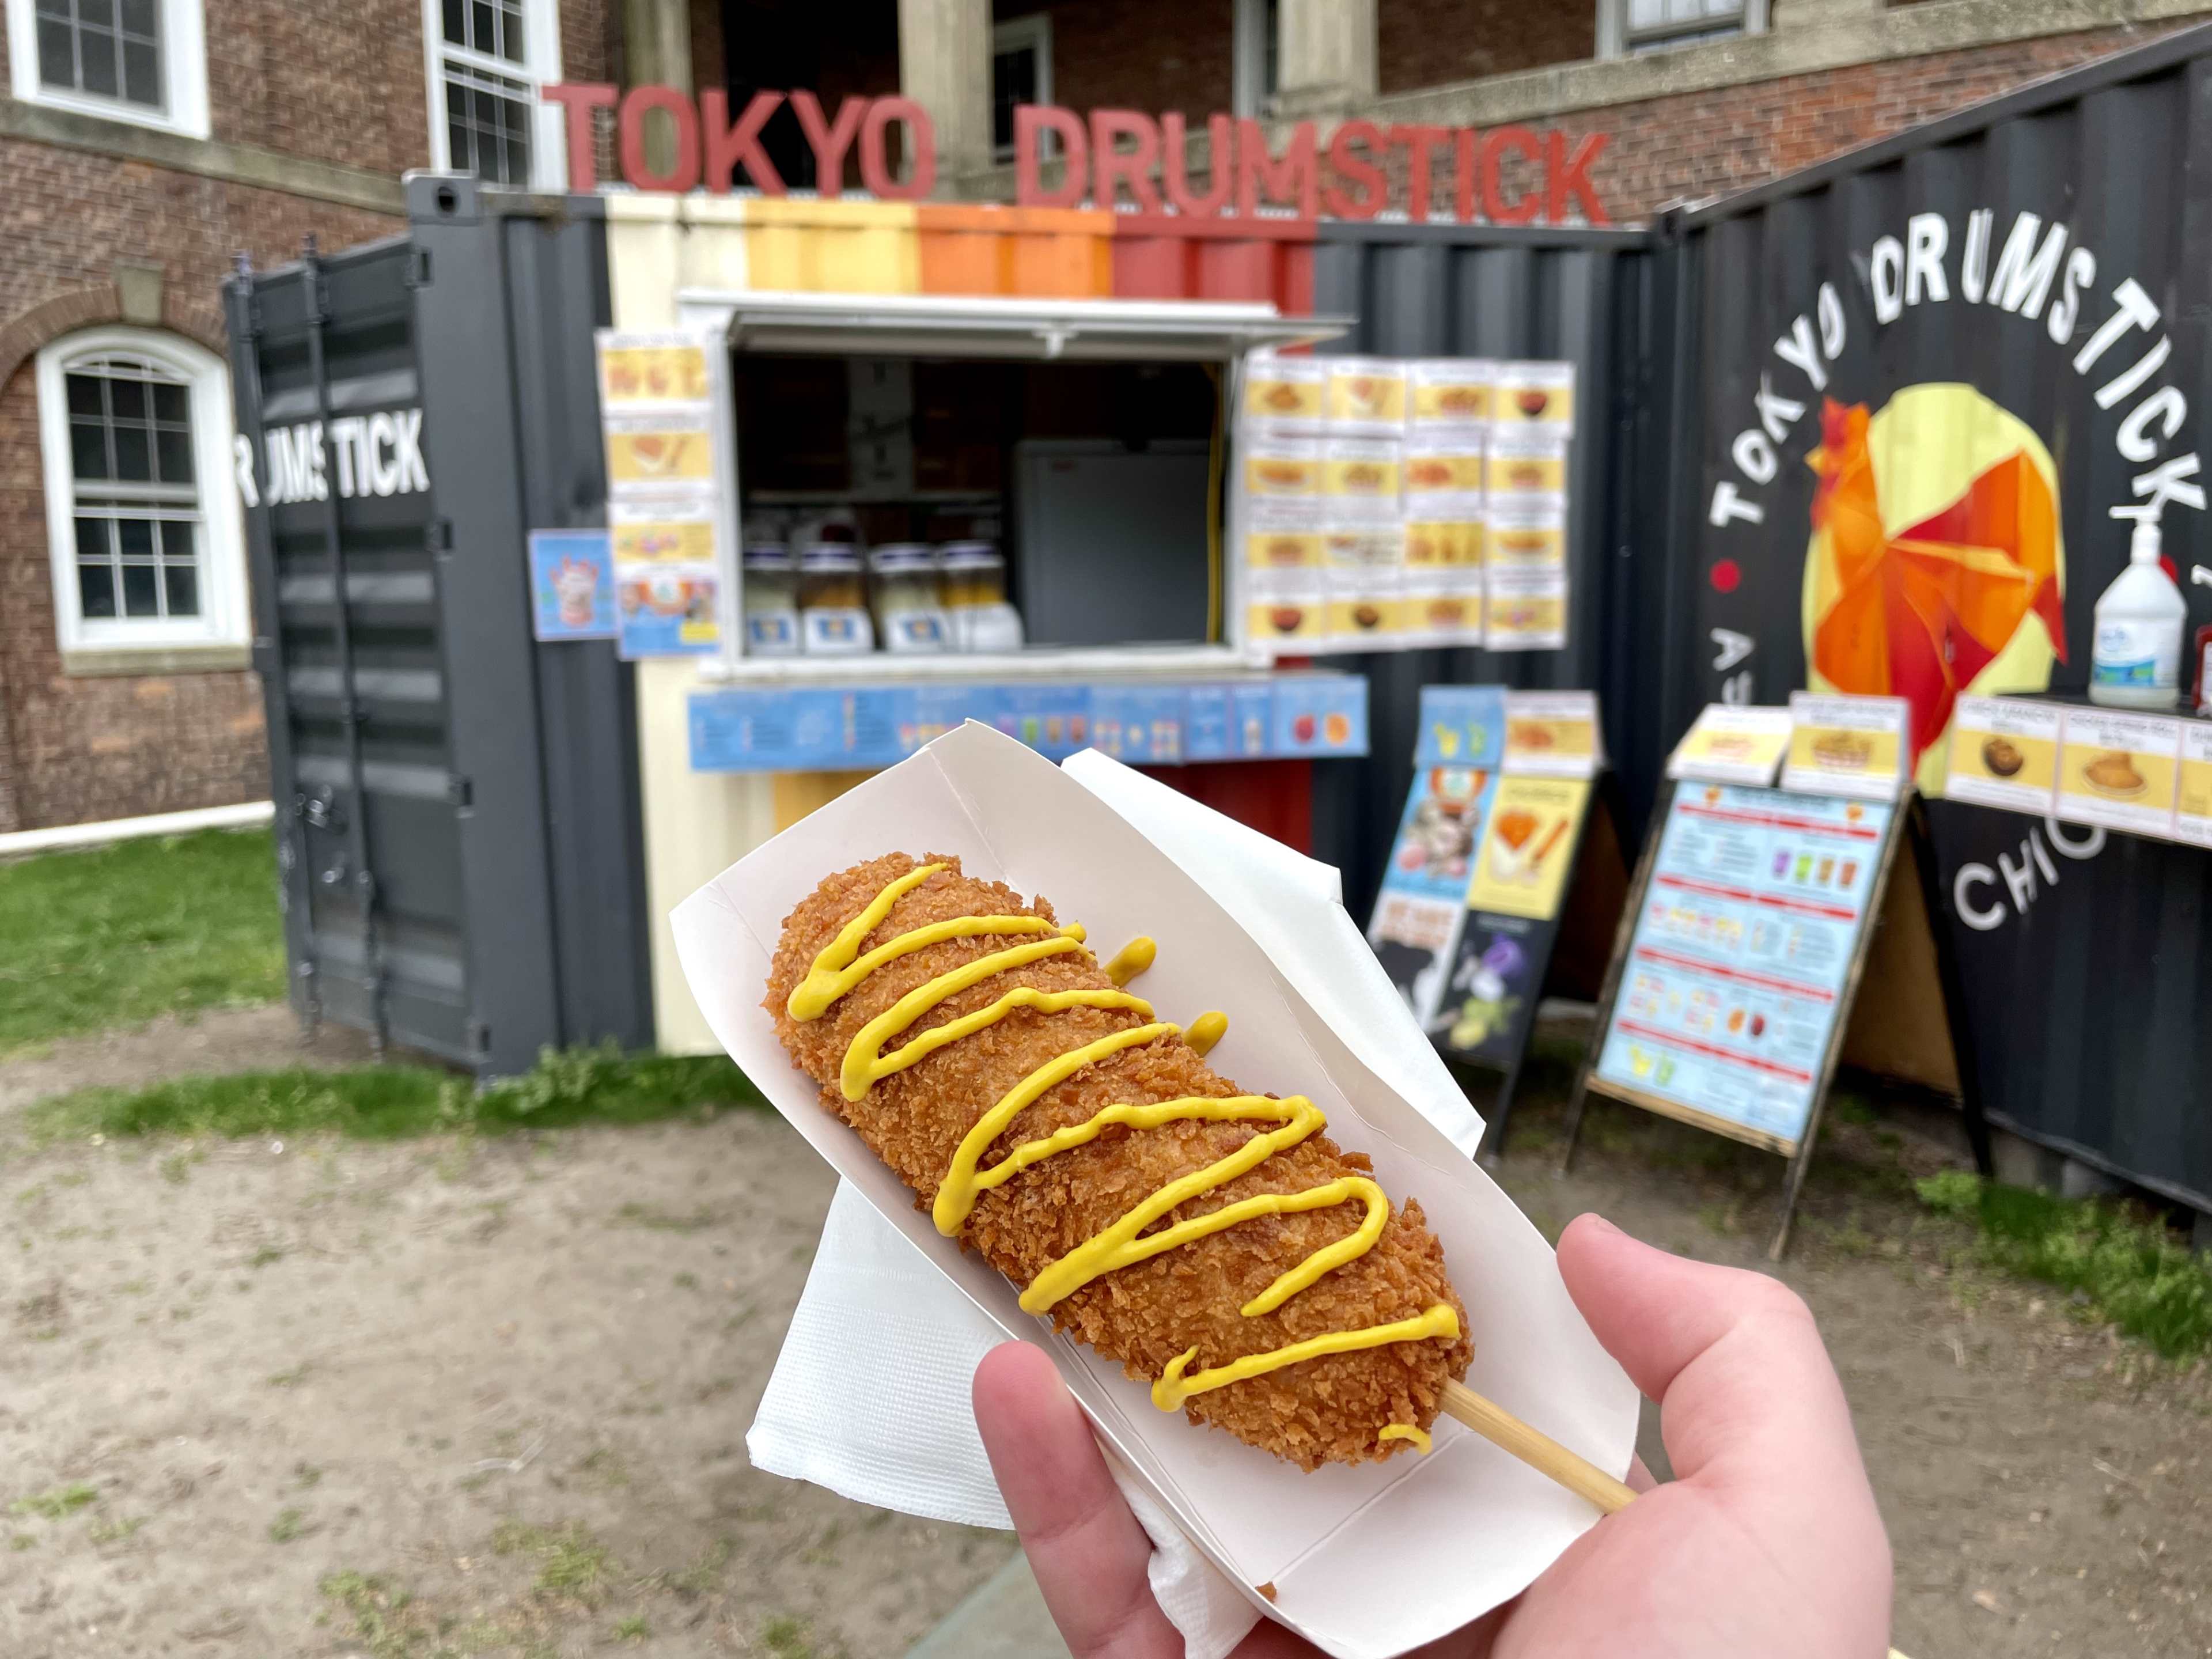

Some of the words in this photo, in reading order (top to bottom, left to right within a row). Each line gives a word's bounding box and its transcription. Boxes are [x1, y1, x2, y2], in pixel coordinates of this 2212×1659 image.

[542, 82, 936, 200] TOKYO
[1014, 104, 1611, 227] DRUMSTICK
[1709, 282, 1847, 527] TOKYO
[1870, 208, 2207, 509] DRUMSTICK
